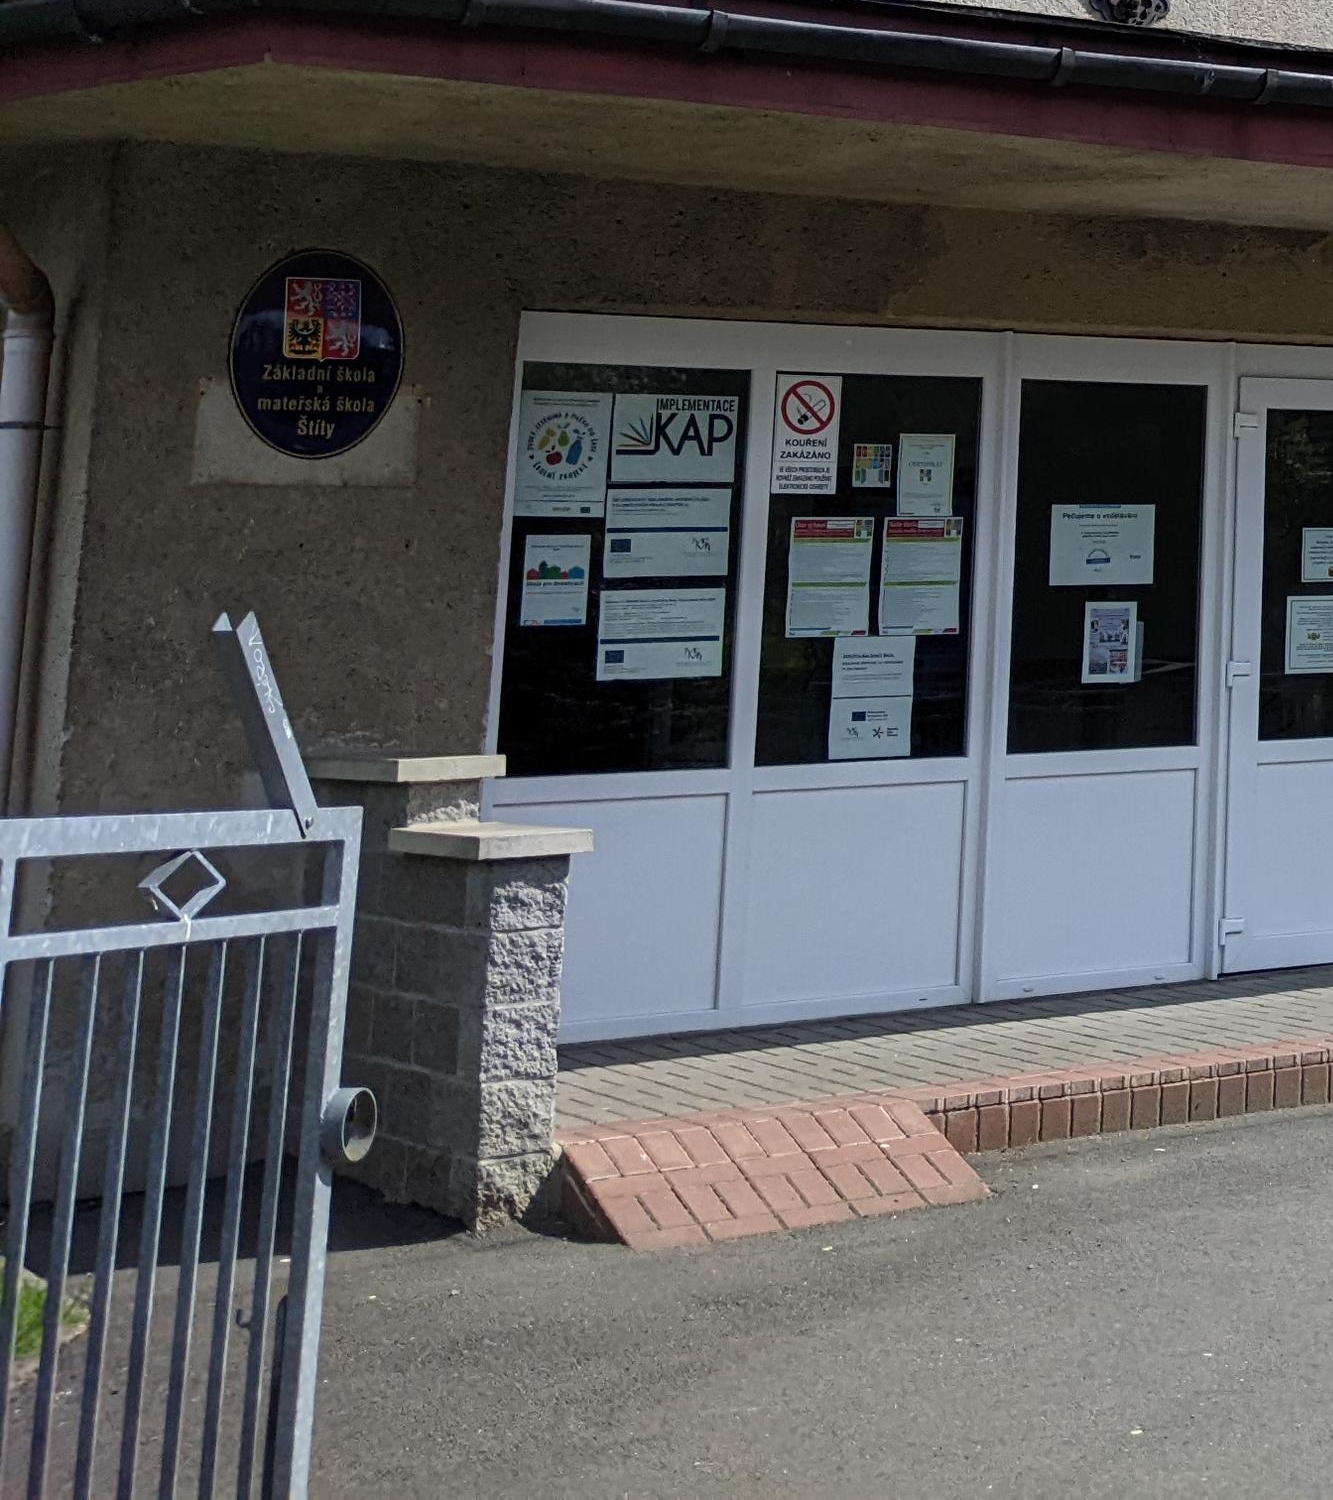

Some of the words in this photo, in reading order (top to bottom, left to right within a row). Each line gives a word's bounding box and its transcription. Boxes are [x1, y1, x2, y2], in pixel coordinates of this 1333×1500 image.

[262, 364, 331, 382] Základní
[336, 366, 375, 383] škola
[257, 396, 330, 412] mateřská
[336, 397, 375, 413] škola
[657, 399, 735, 412] IMPLEMENTACE
[297, 415, 335, 439] Štíty
[655, 413, 733, 456] KAP
[785, 438, 828, 447] KOUŘENÍ
[780, 449, 831, 459] ZAKÁZÁNO
